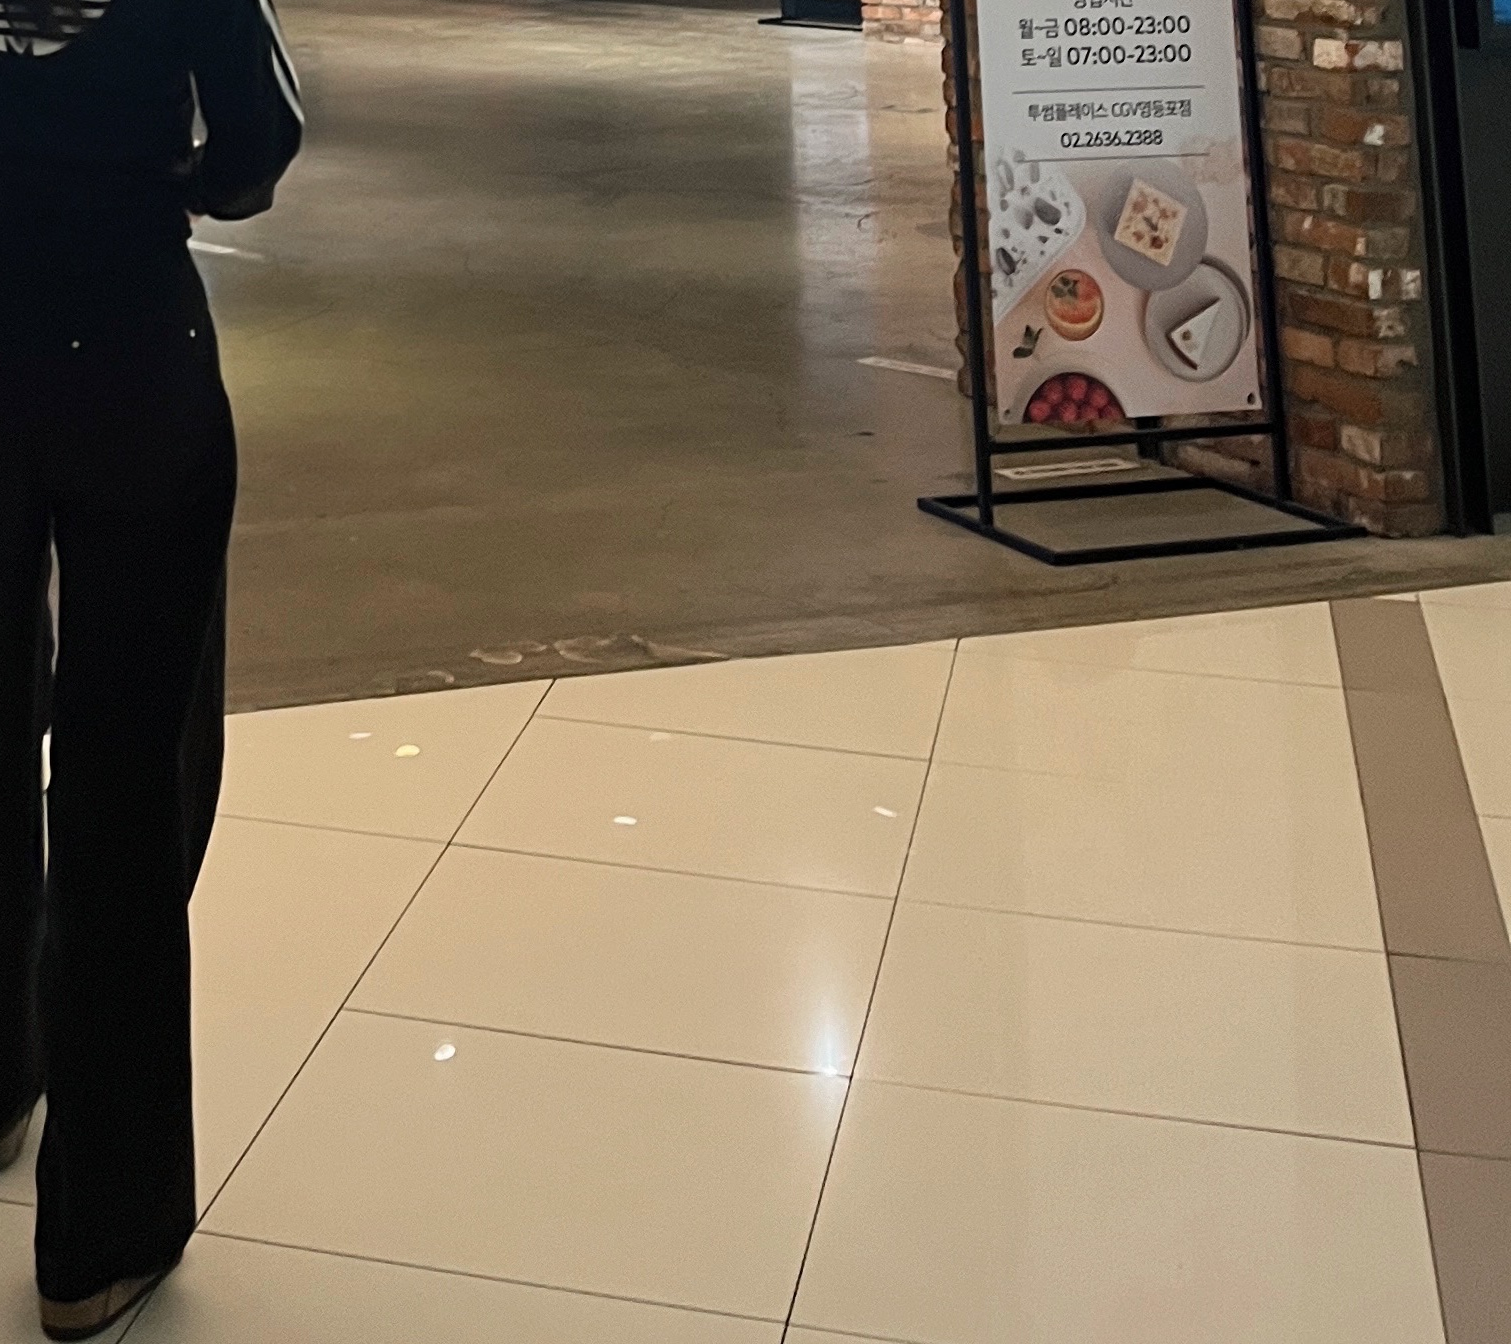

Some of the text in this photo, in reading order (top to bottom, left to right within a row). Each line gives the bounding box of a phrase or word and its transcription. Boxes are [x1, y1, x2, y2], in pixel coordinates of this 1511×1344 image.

[1063, 14, 1191, 38] 08:00-23:00
[1066, 42, 1192, 67] 07:00-23:00
[1027, 102, 1110, 123] 투썸플레이스
